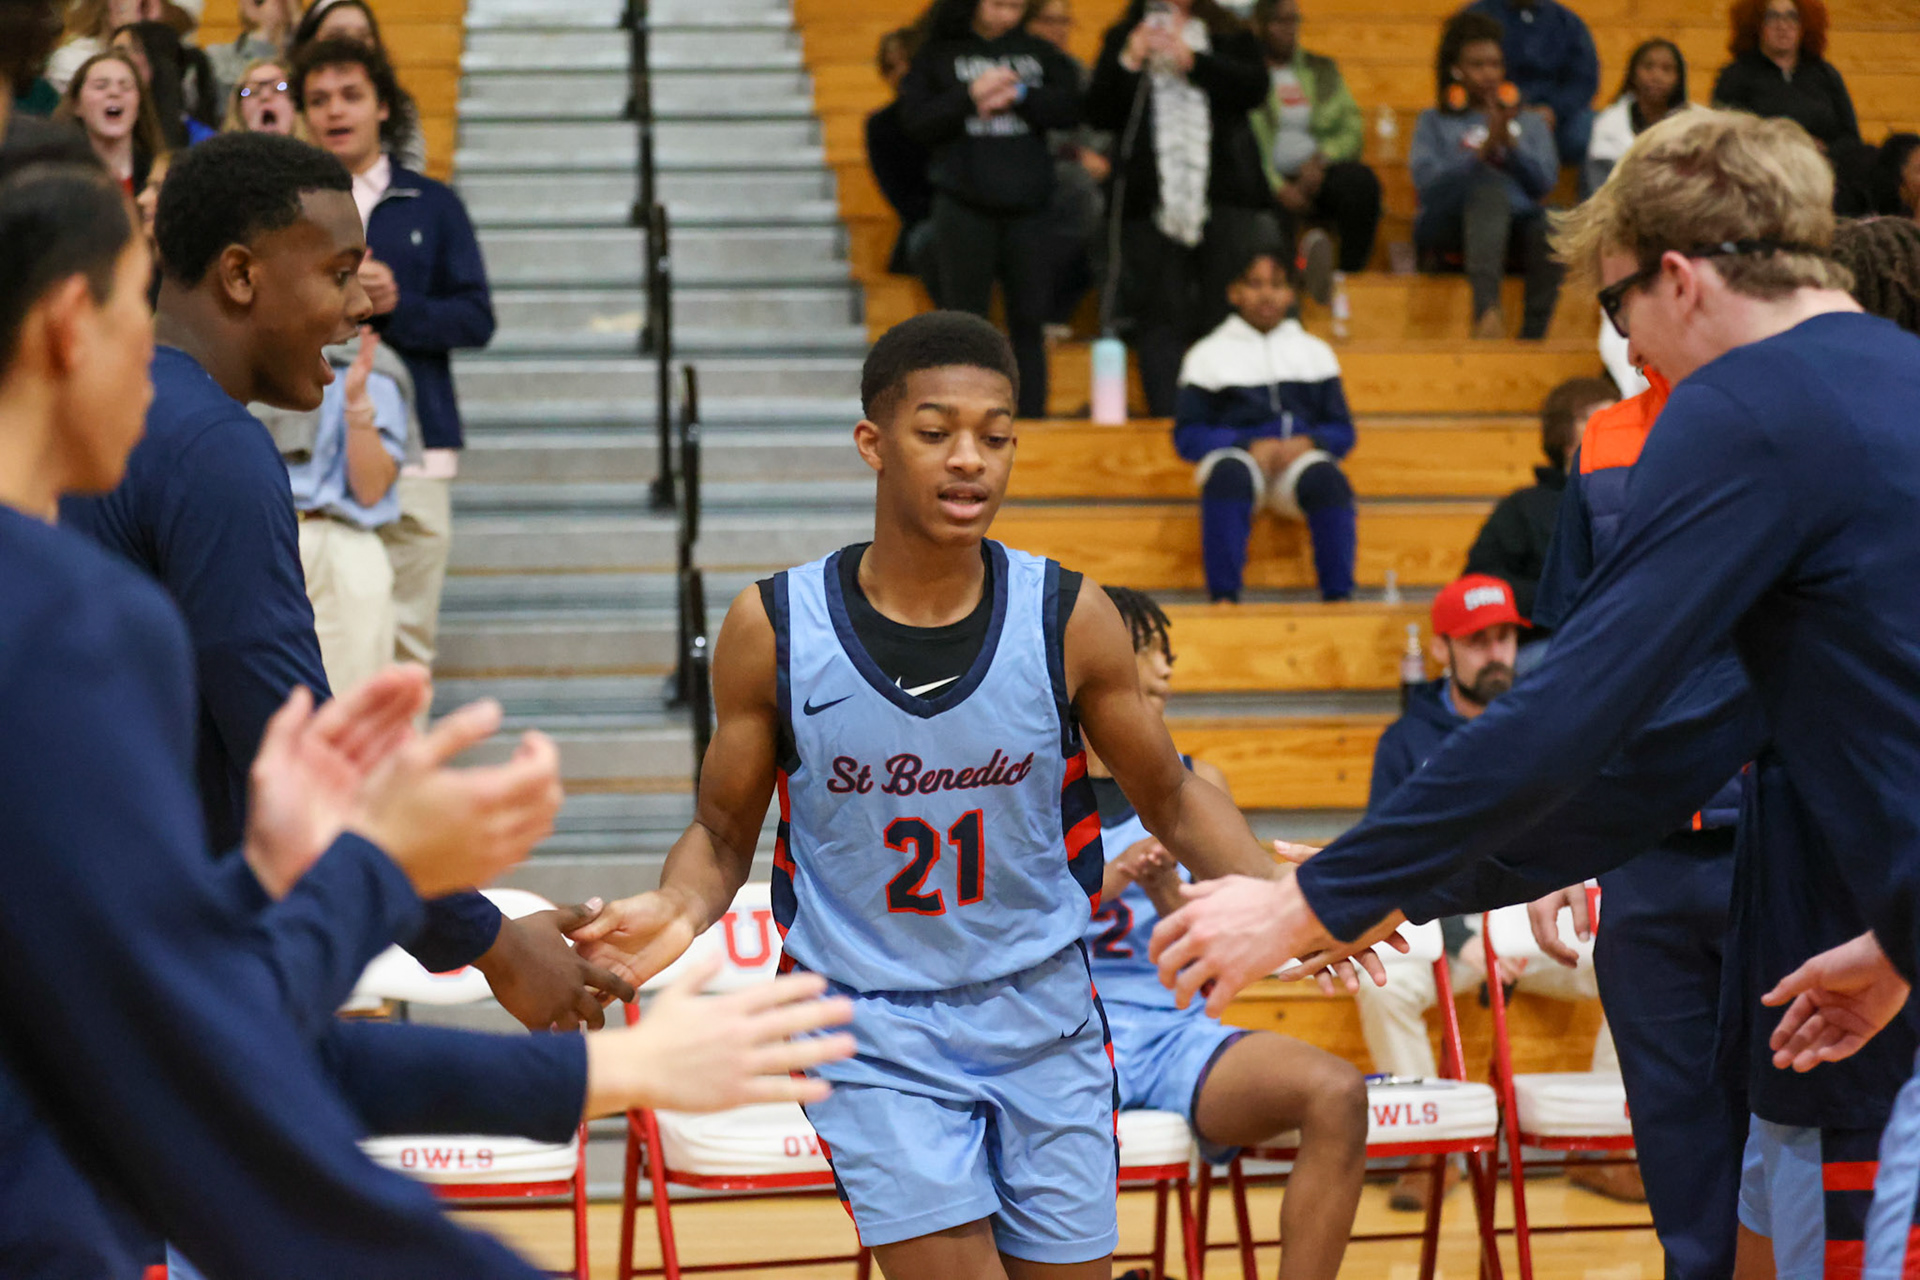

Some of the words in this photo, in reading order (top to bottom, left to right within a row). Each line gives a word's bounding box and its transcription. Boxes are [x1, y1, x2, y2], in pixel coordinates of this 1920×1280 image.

[826, 755, 874, 795] St
[881, 748, 1035, 797] Benedict
[883, 808, 986, 917] 21
[719, 909, 772, 968] U
[1372, 1101, 1439, 1127] WLS
[400, 1147, 495, 1170] OWLS
